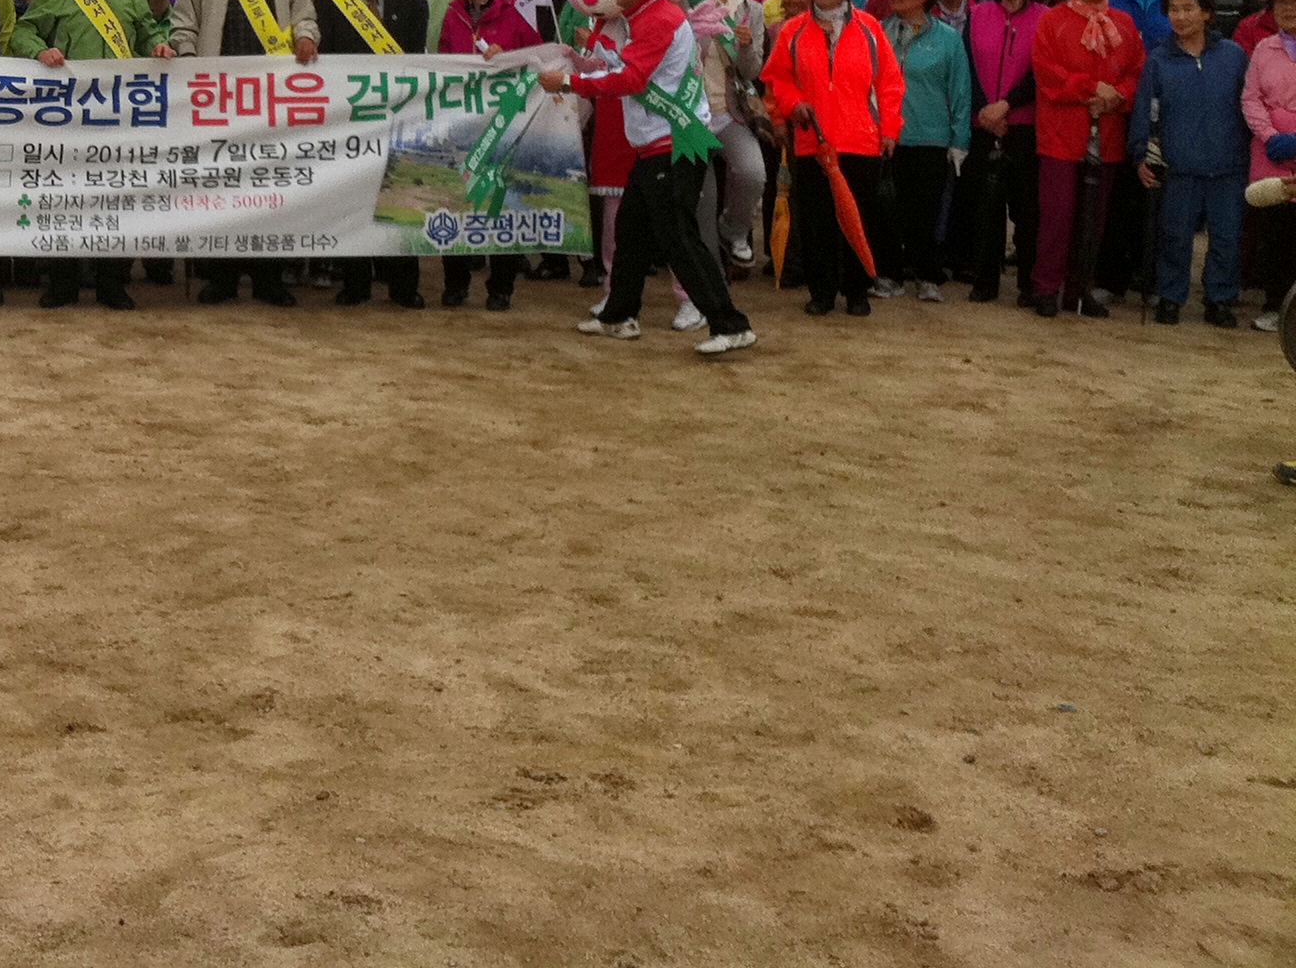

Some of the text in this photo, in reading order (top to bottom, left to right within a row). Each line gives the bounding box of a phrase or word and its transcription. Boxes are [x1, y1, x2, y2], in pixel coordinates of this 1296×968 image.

[187, 72, 330, 127] 한마음
[347, 65, 527, 122] 걷기대회
[23, 143, 64, 165] 일시
[85, 144, 158, 165] 2011년
[166, 146, 200, 165] 5월
[210, 139, 288, 164] 7일(토)
[295, 140, 336, 161] 오전
[345, 135, 383, 160] 9시
[20, 169, 64, 189] 장소
[85, 170, 148, 189] 보강천
[157, 167, 242, 189] 체육공원
[249, 166, 315, 187] 운동장
[37, 194, 85, 211] 참가자
[89, 194, 136, 211] 기념품
[36, 214, 120, 231] 행운권 추첨
[463, 211, 562, 245] 증평신협
[80, 234, 126, 252] 자전거
[198, 234, 229, 252] 기타
[234, 234, 296, 252] 생활용품
